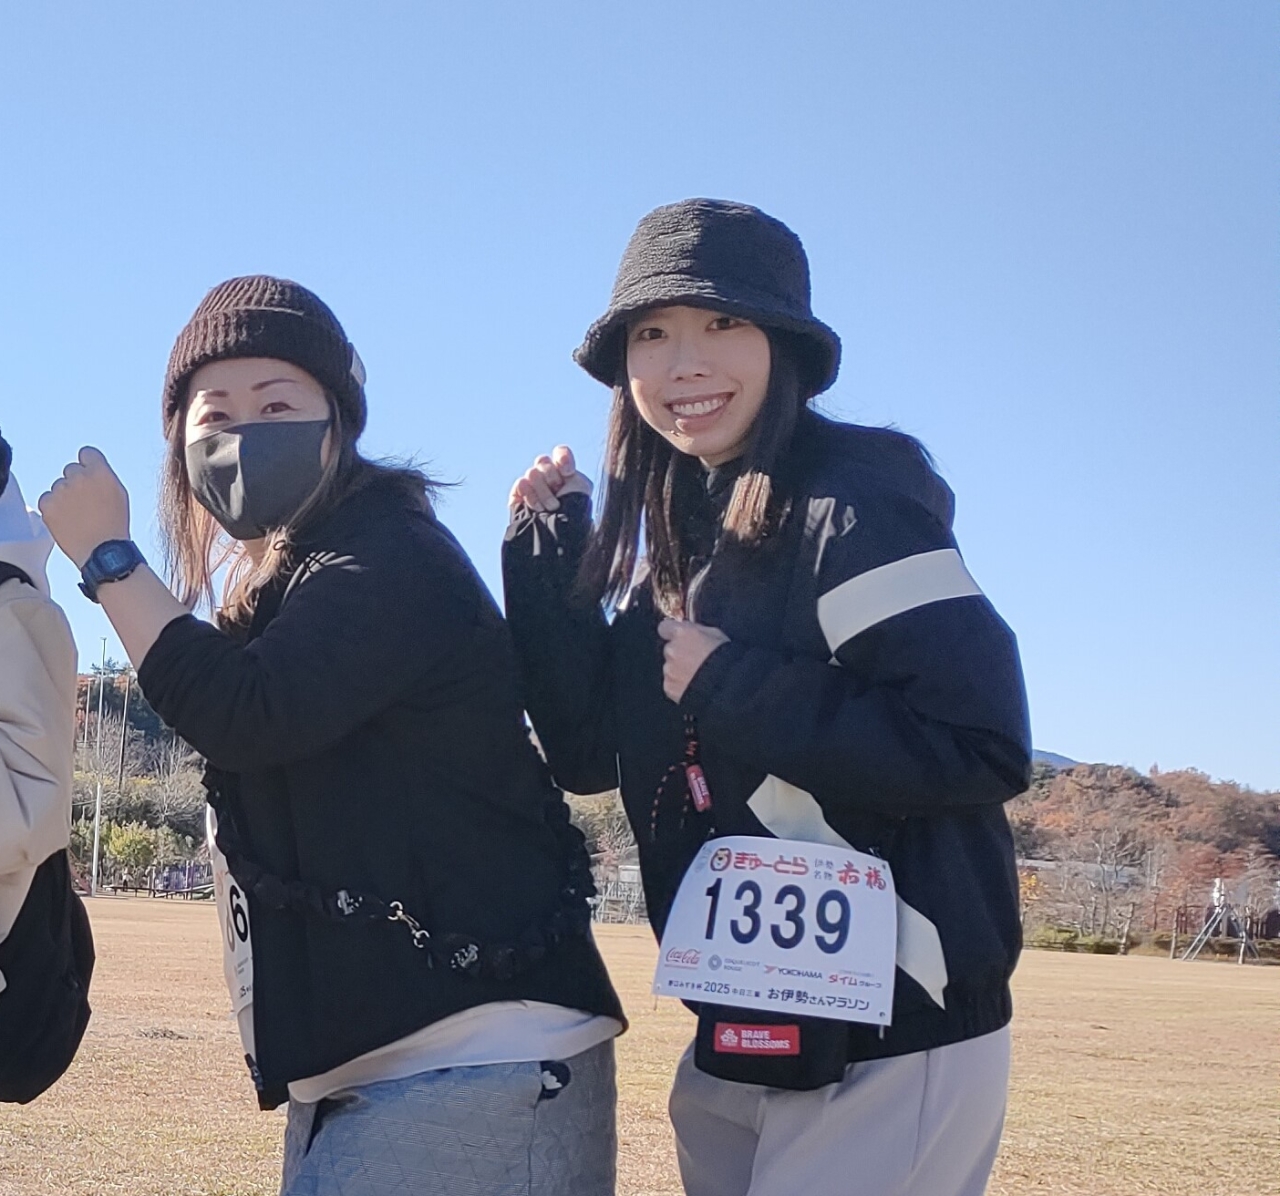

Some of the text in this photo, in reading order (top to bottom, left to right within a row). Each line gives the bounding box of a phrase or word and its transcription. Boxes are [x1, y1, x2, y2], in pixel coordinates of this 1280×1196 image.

[733, 852, 810, 876] ぎゅーとら
[705, 877, 851, 954] 1339
[777, 967, 823, 979] YOKOHAMA
[703, 981, 730, 994] 2025
[767, 987, 870, 1011] お伊勢さんマラソン
[741, 1029, 771, 1040] BRAVE
[741, 1038, 791, 1050] BLOSSOMS
